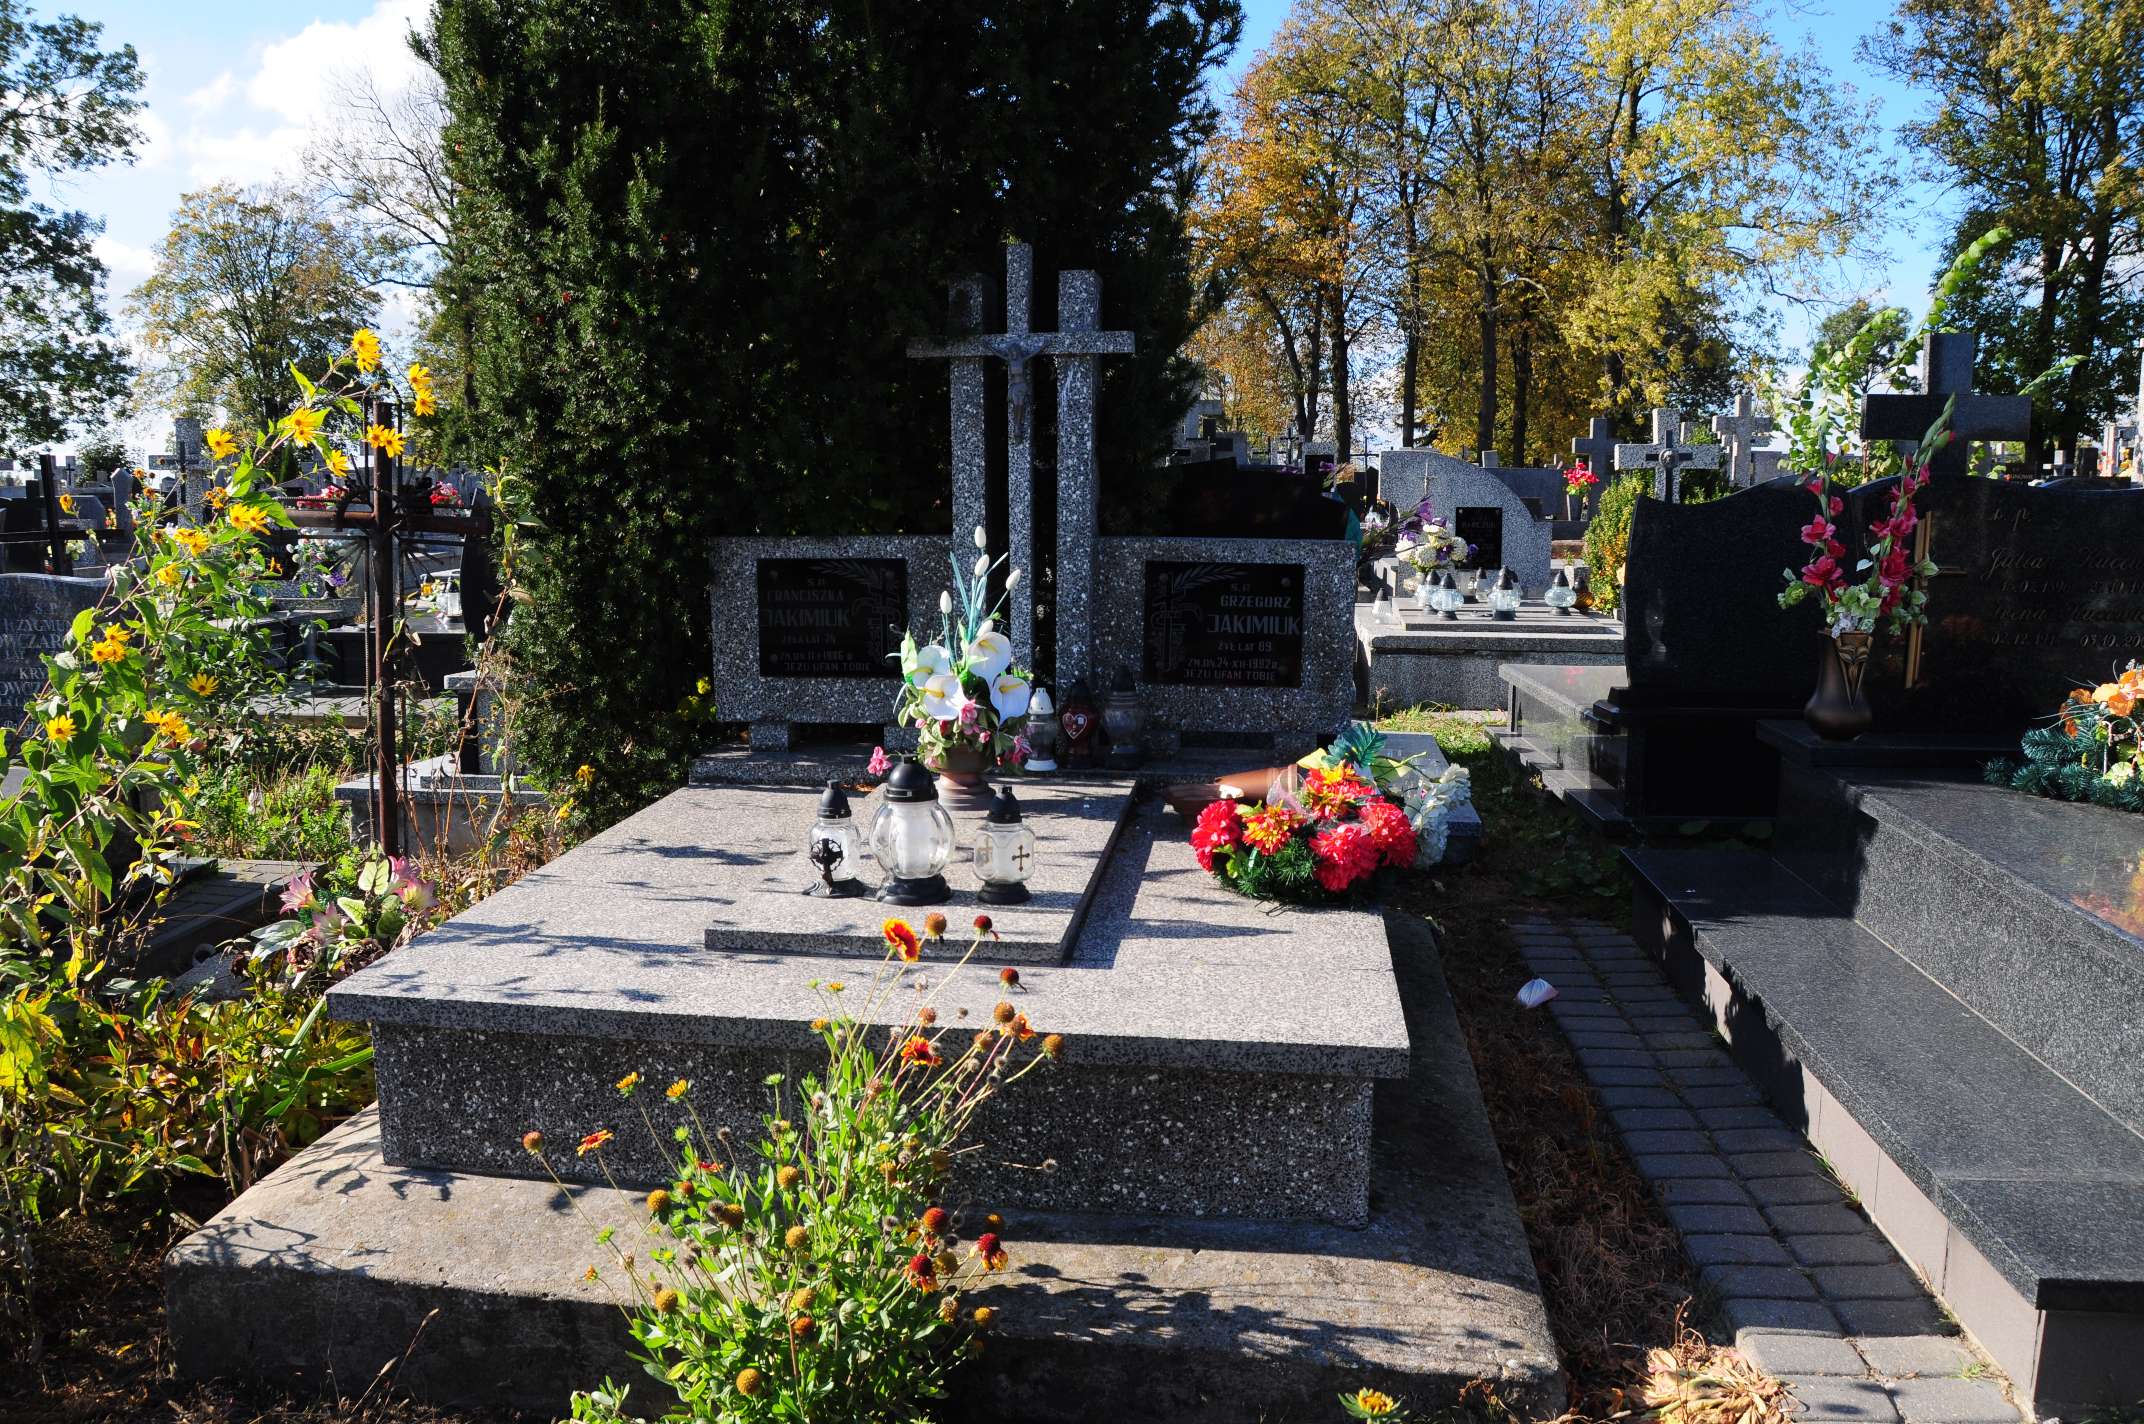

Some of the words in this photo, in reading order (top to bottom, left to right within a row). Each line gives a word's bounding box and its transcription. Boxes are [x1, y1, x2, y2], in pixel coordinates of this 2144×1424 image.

[767, 589, 845, 601] FRANCISZKA
[1220, 594, 1293, 609] GRZEGORZ
[760, 608, 850, 628] JAKIMIUK
[1207, 614, 1301, 635] JAKIMIUK
[1214, 670, 1243, 681] UFAM
[1246, 671, 1278, 681] TOBIE
